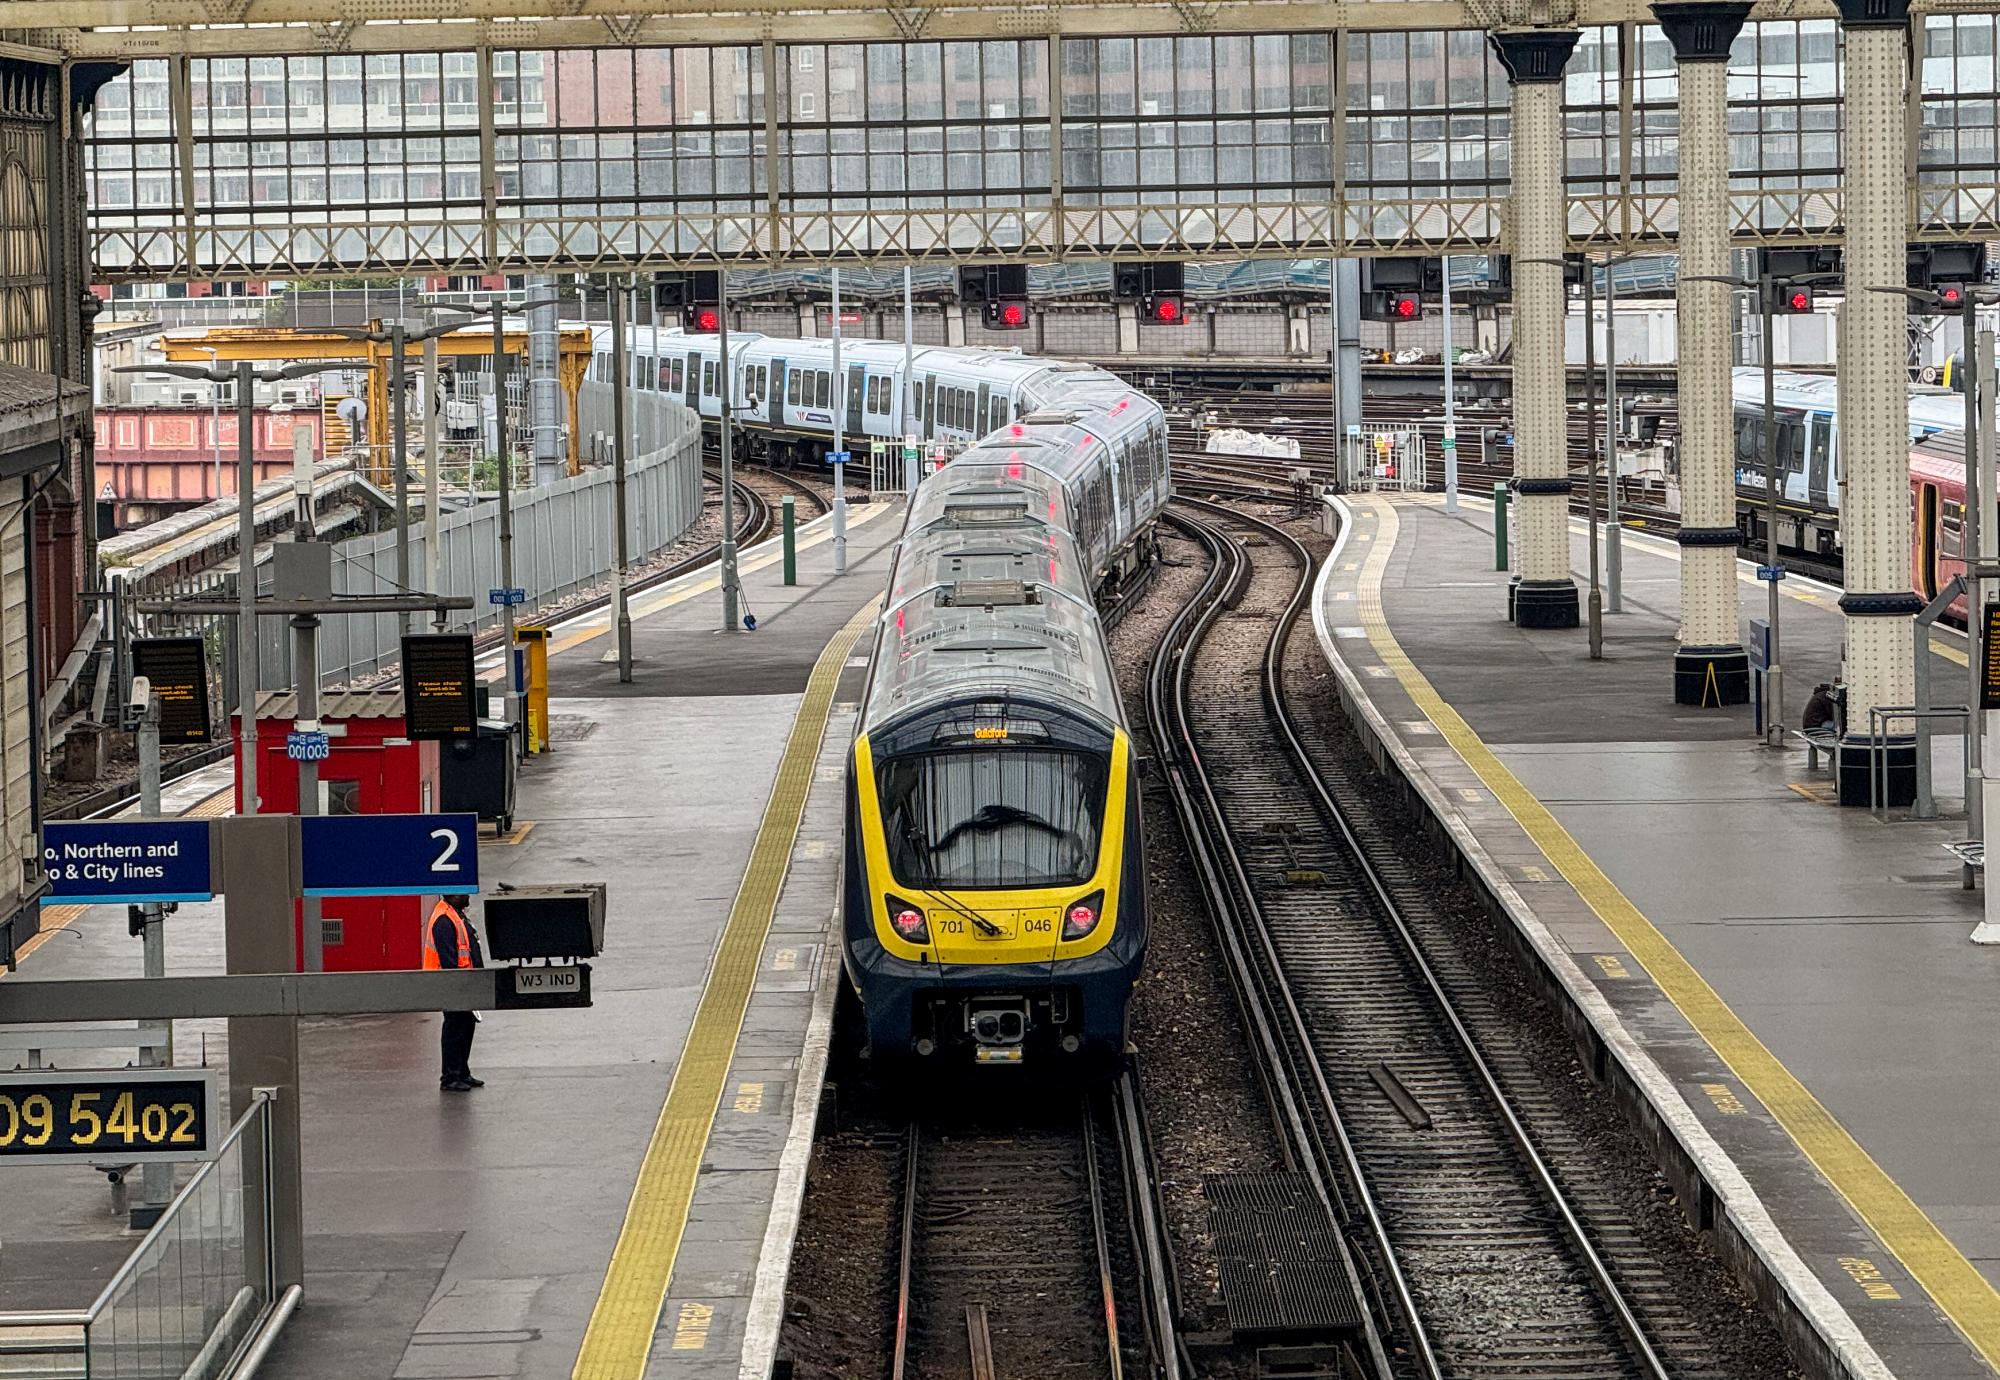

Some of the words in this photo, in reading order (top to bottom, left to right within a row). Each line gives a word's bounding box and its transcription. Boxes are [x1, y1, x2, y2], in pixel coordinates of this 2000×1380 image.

[974, 728, 1007, 738] Guildford
[289, 745, 306, 759] 001
[307, 745, 329, 759] 003
[65, 843, 142, 859] Northern
[147, 841, 178, 857] and
[430, 828, 460, 871] 2
[65, 864, 79, 879] &
[84, 863, 119, 882] City
[124, 862, 164, 878] lines
[939, 920, 965, 934] 701
[1024, 919, 1052, 932] 046
[520, 975, 543, 987] W3
[550, 974, 575, 986] IND
